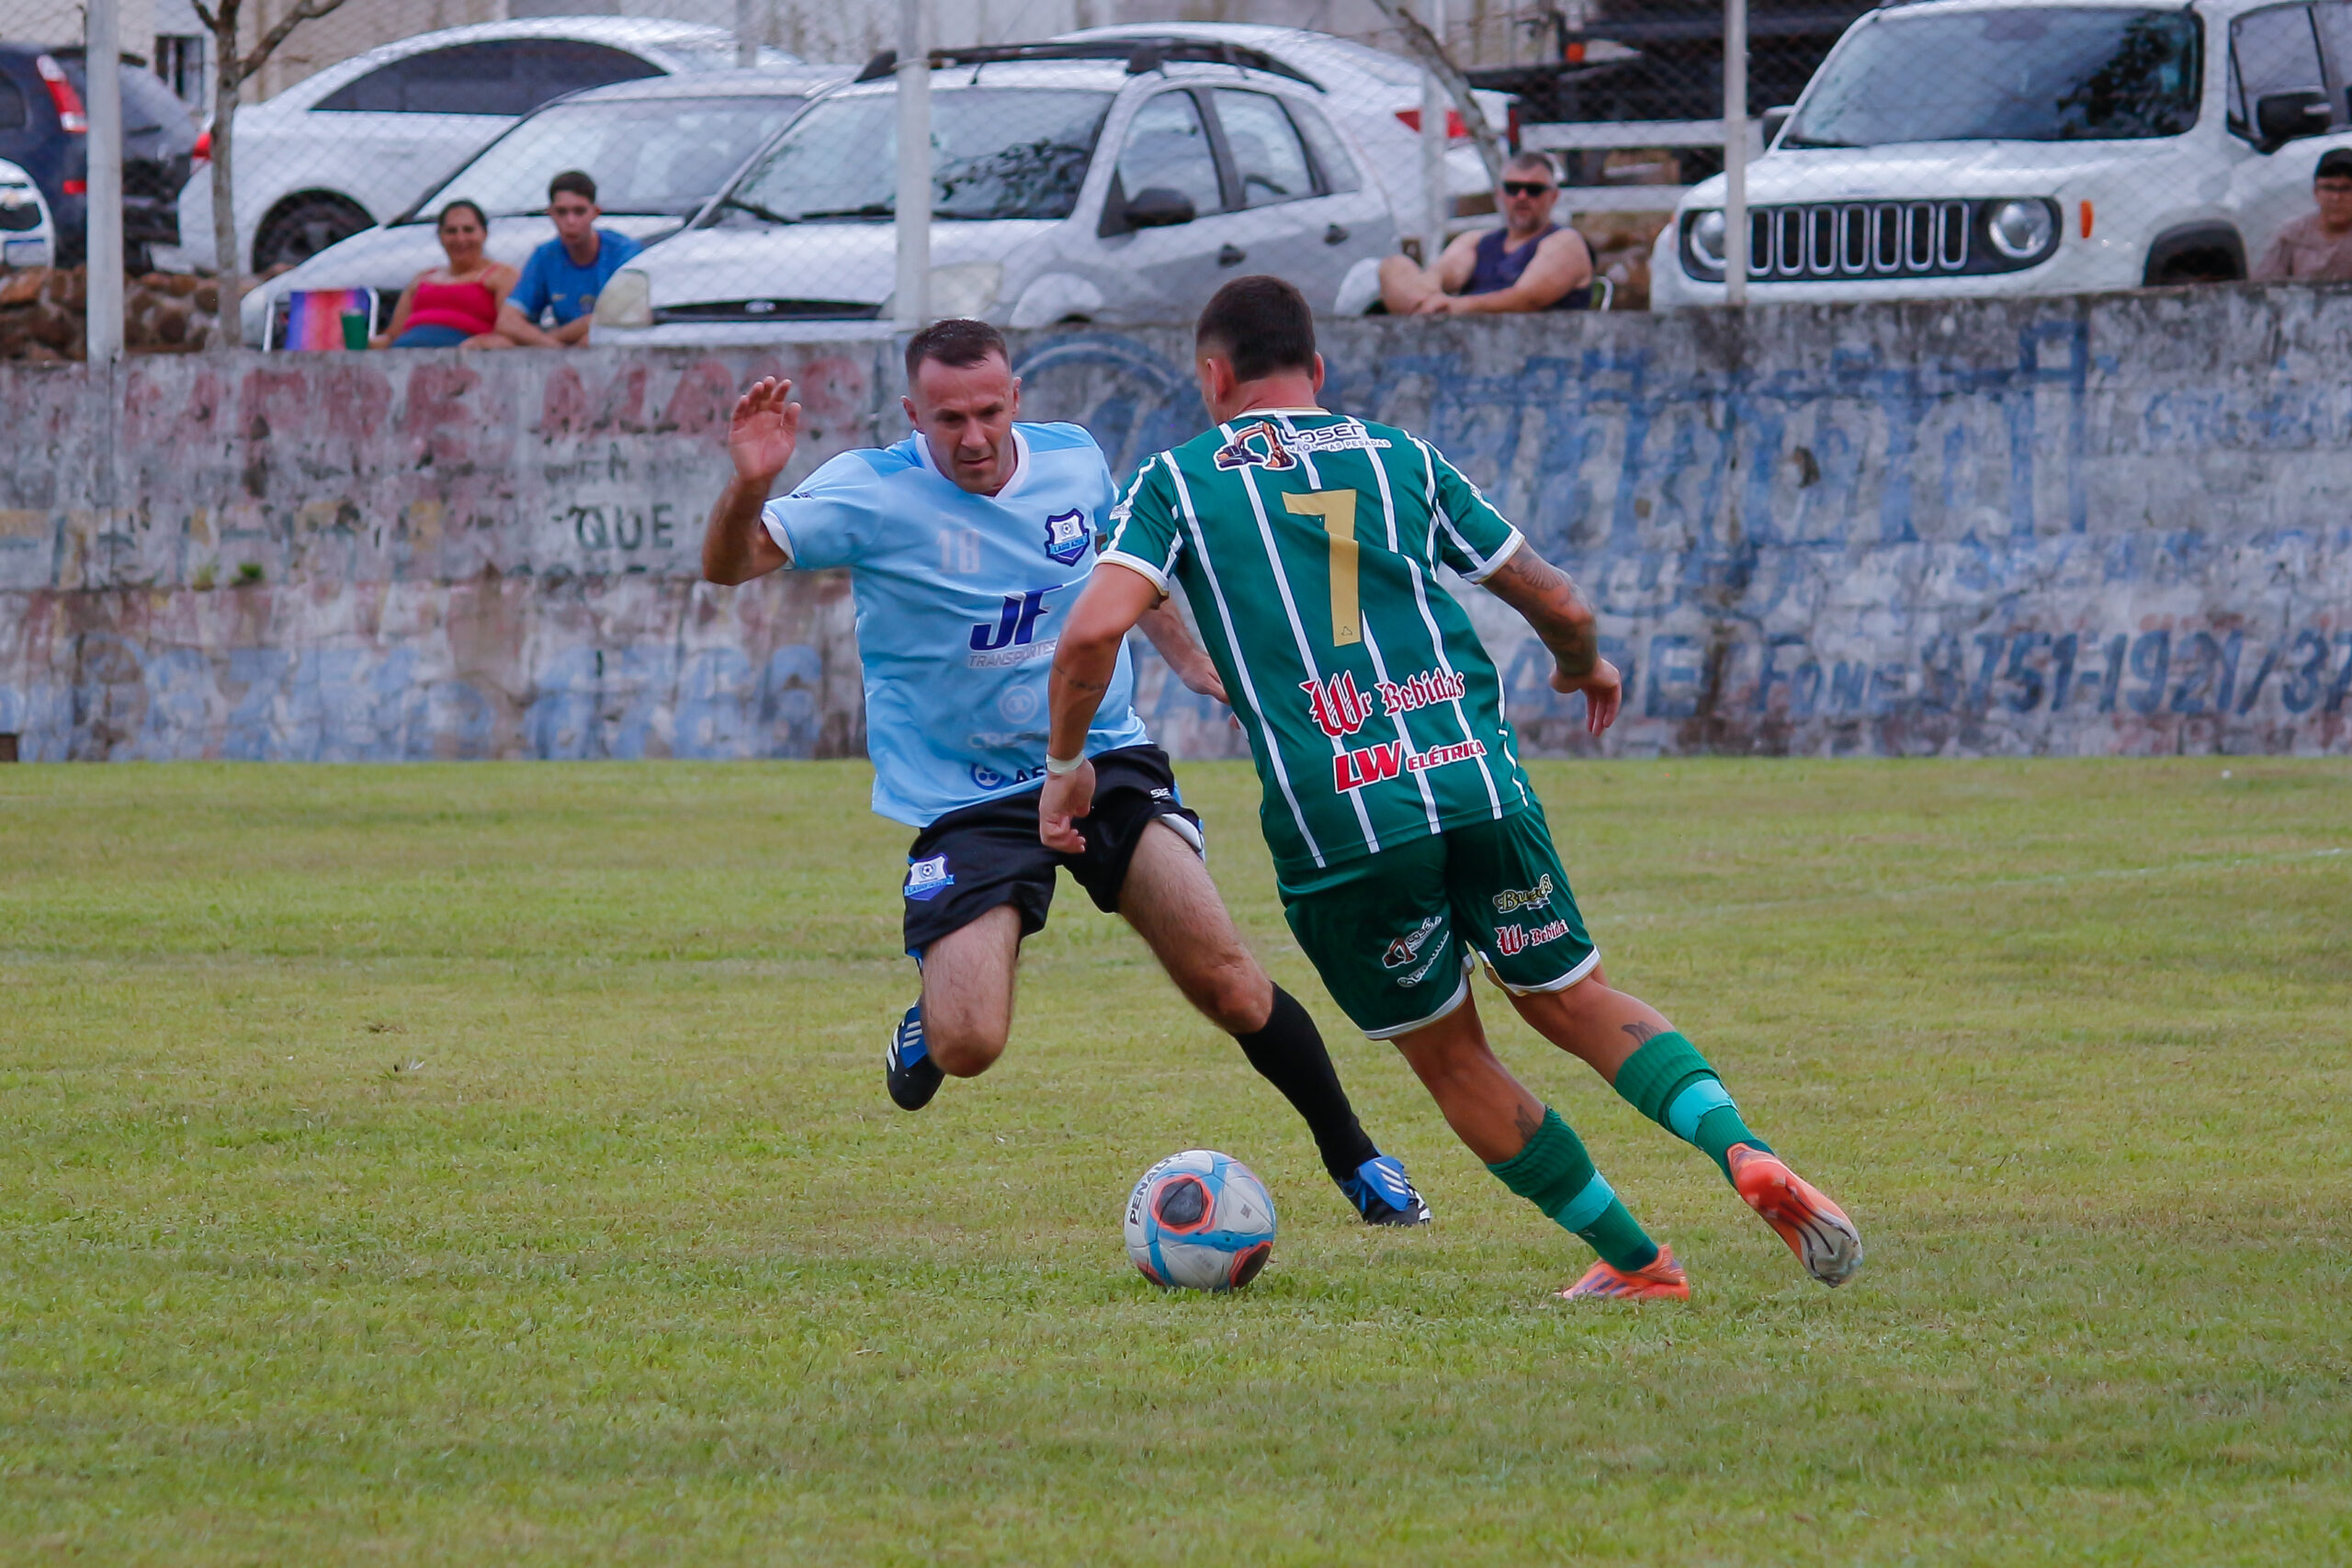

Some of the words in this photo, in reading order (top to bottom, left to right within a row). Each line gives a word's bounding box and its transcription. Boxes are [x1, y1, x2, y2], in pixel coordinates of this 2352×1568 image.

[569, 504, 673, 550] QUE
[1281, 489, 1362, 648] 7
[969, 584, 1063, 650] JF
[1375, 669, 1464, 716] Bebidas
[1334, 739, 1402, 793] LW
[1408, 741, 1486, 771] ELÉTRICA
